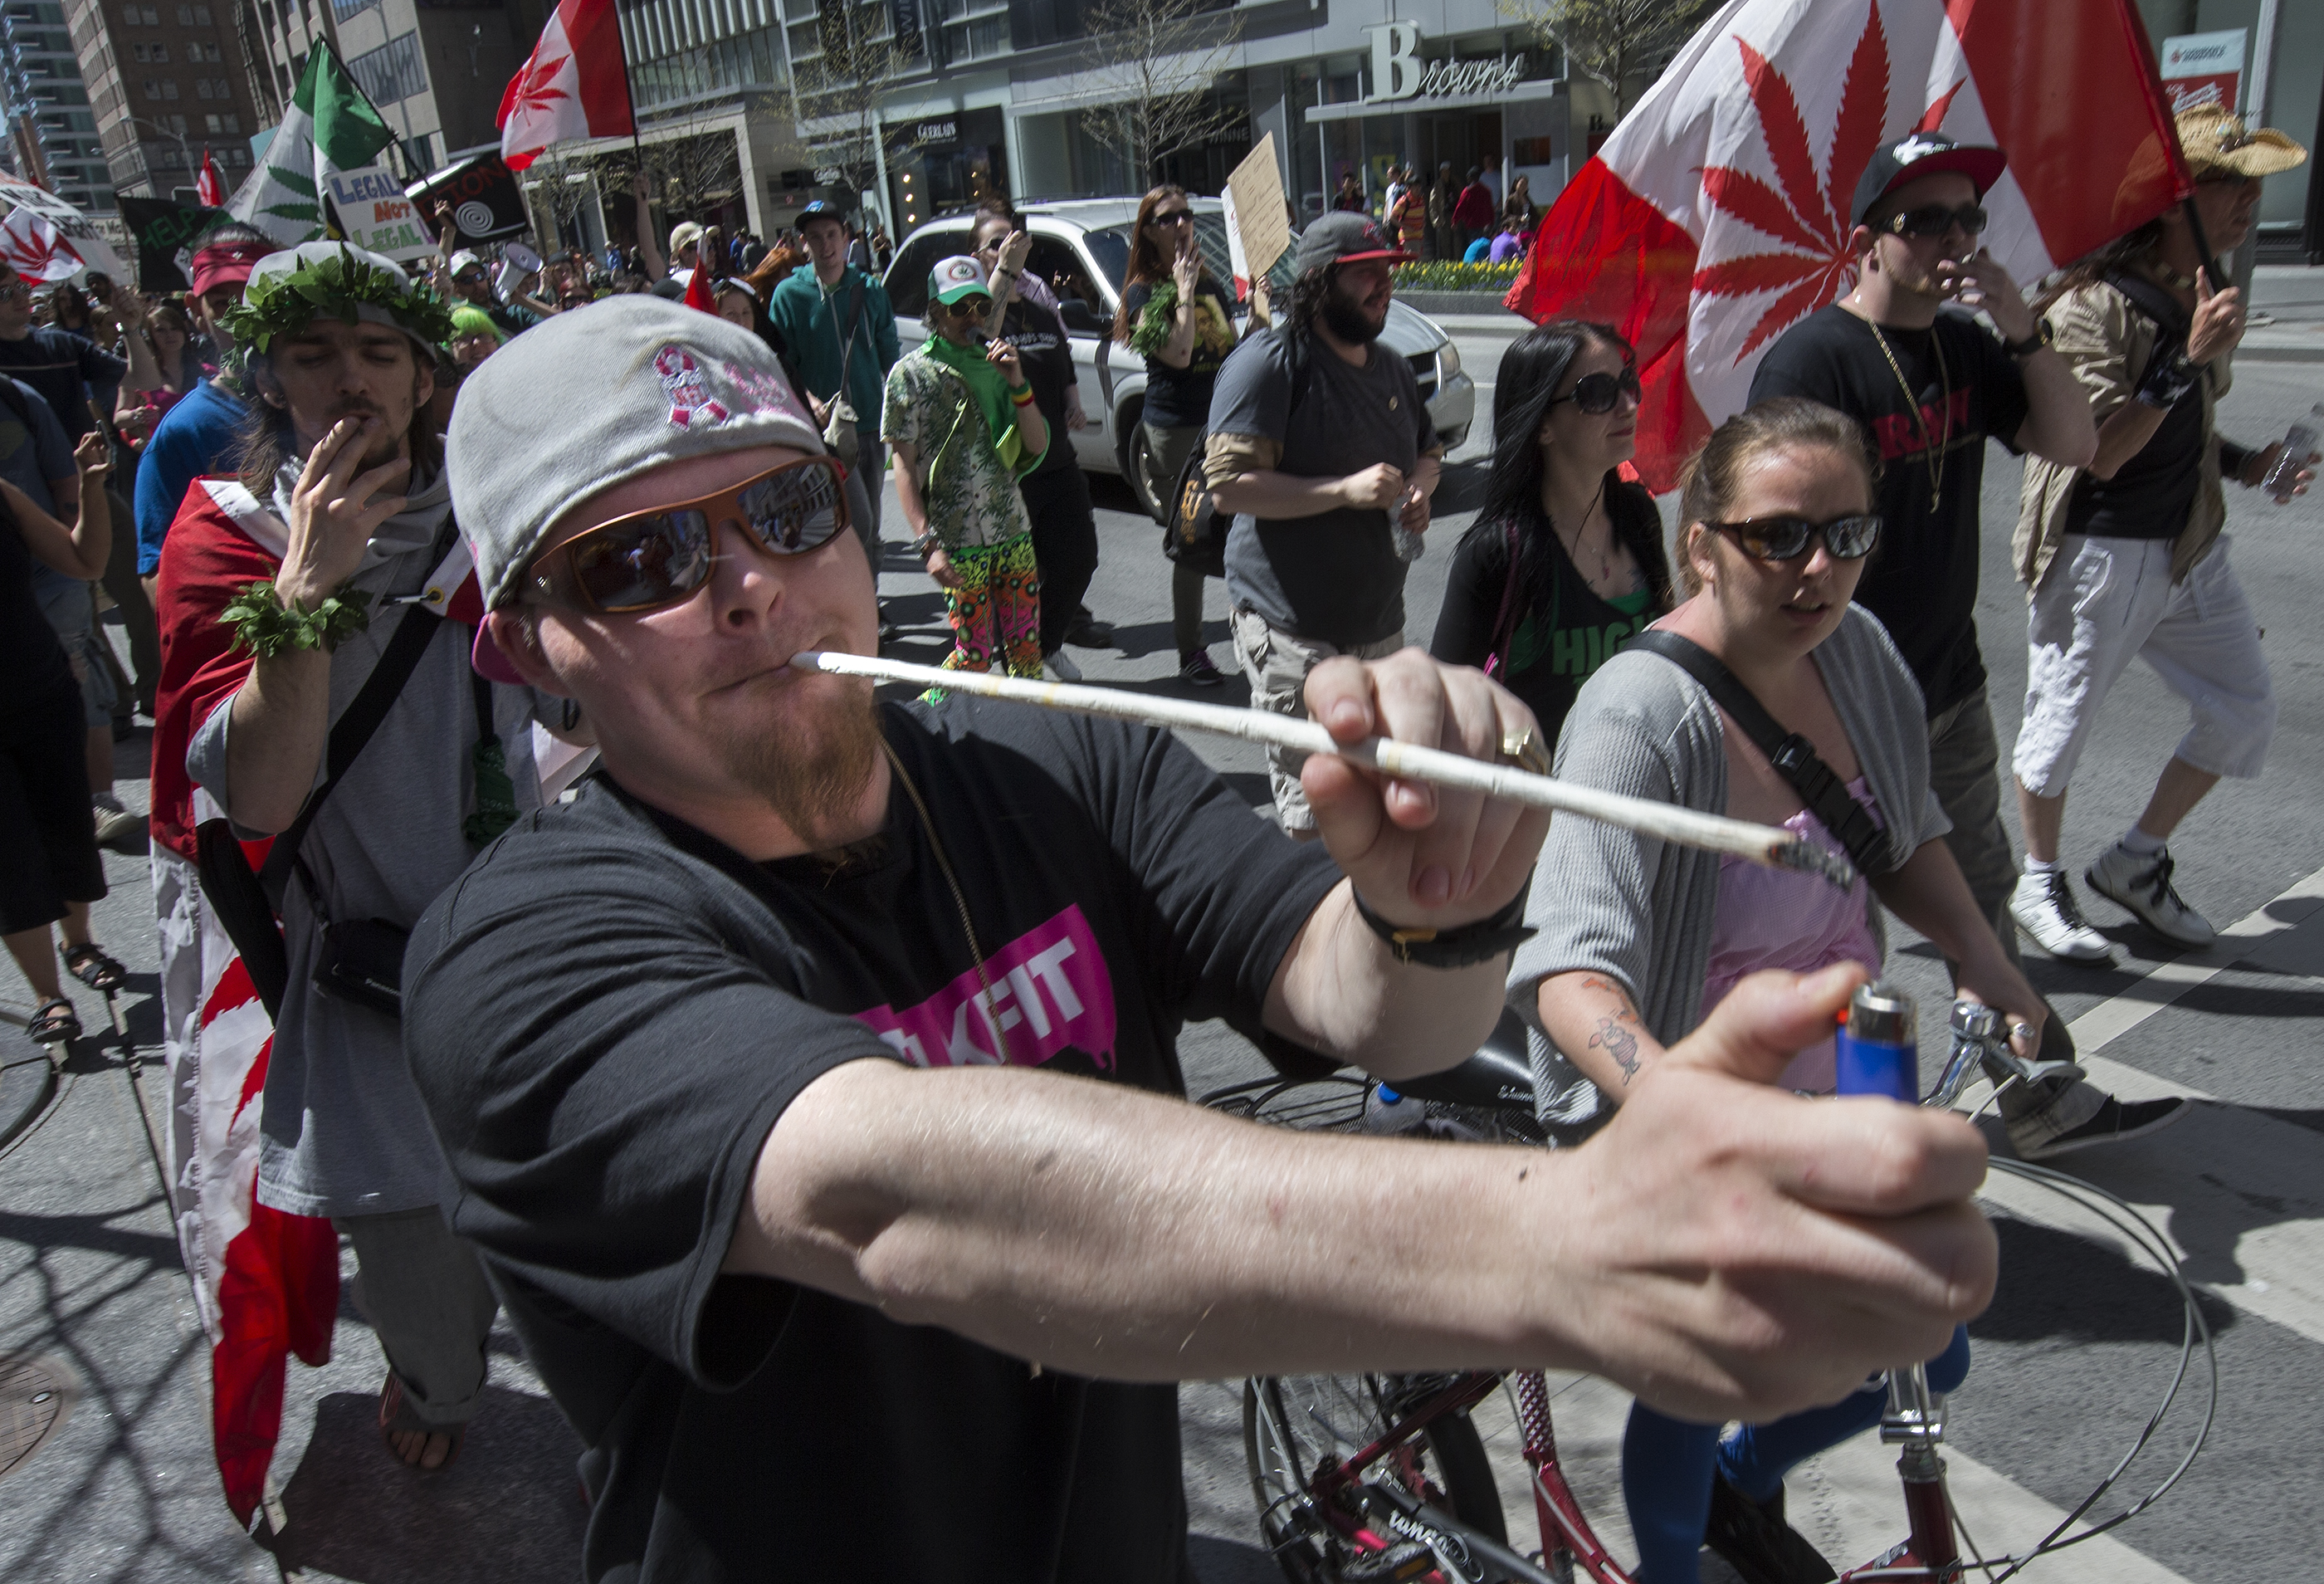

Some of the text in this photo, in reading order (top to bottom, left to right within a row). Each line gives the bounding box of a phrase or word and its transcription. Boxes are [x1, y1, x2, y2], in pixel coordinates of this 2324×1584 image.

[1360, 20, 1526, 105] Browns
[330, 173, 403, 205] LEGAL
[138, 208, 196, 250] HELP
[374, 200, 410, 223] NOT
[1871, 385, 1974, 462] RAW
